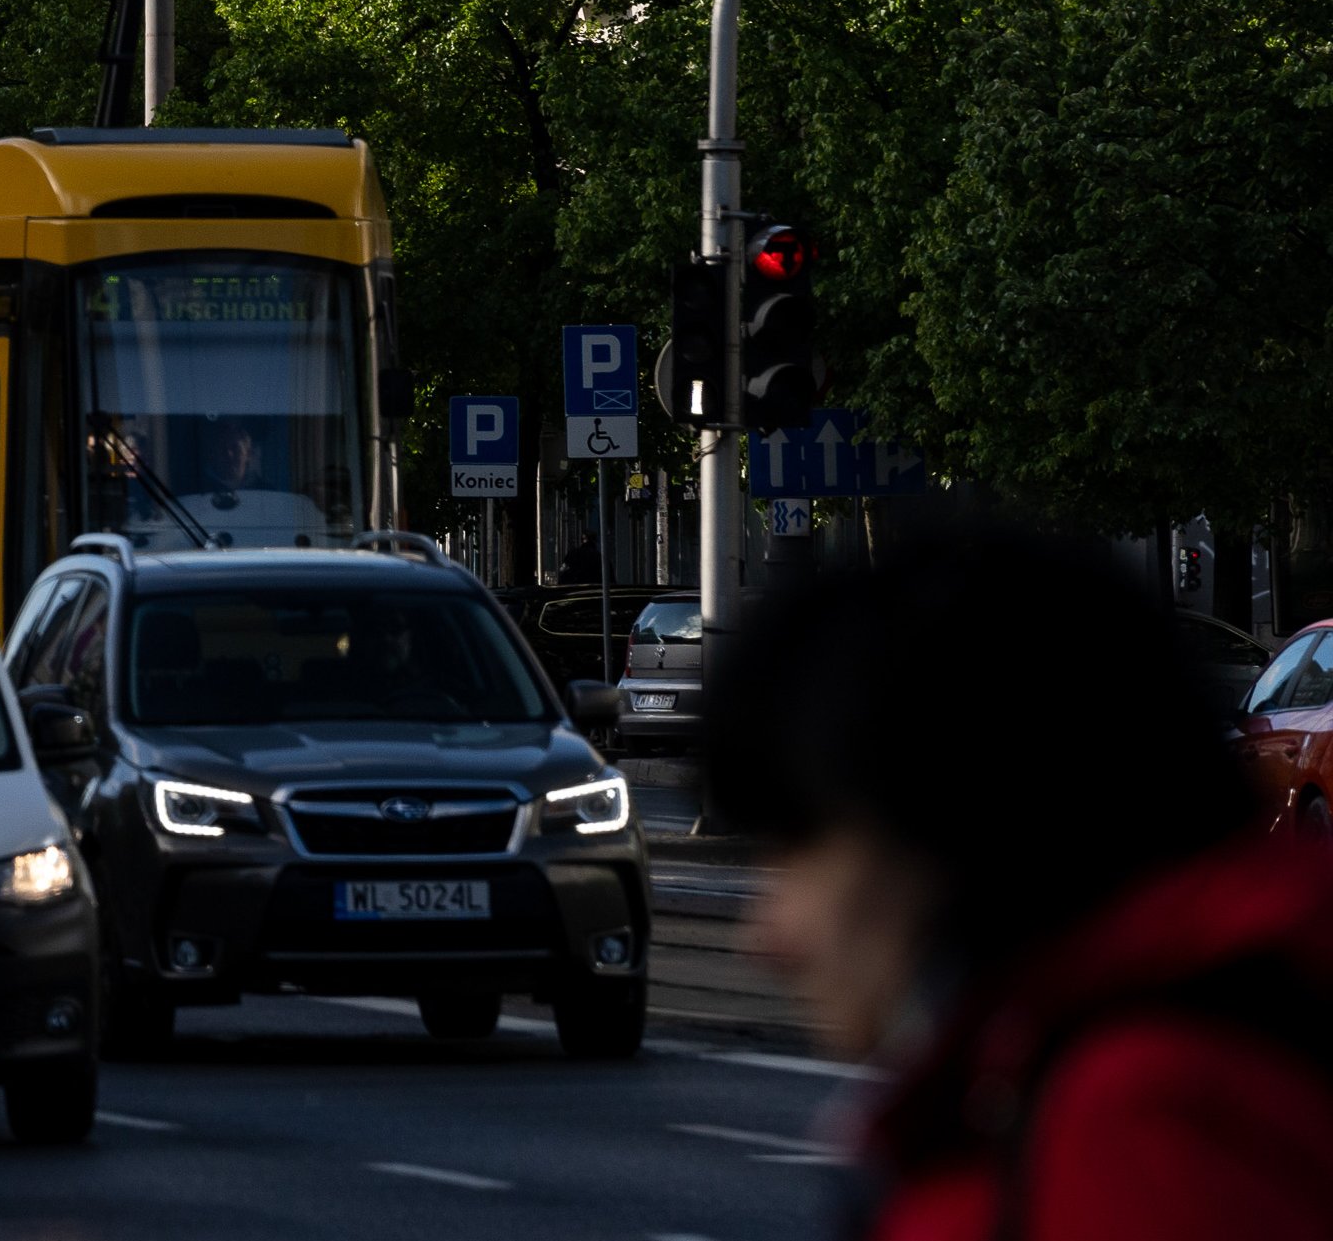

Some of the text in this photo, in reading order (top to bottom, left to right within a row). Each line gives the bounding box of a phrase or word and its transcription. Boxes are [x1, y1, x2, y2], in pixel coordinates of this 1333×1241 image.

[581, 334, 622, 389] P
[466, 404, 504, 456] P
[454, 472, 515, 489] Koniec
[351, 883, 484, 911] WL 5024L
